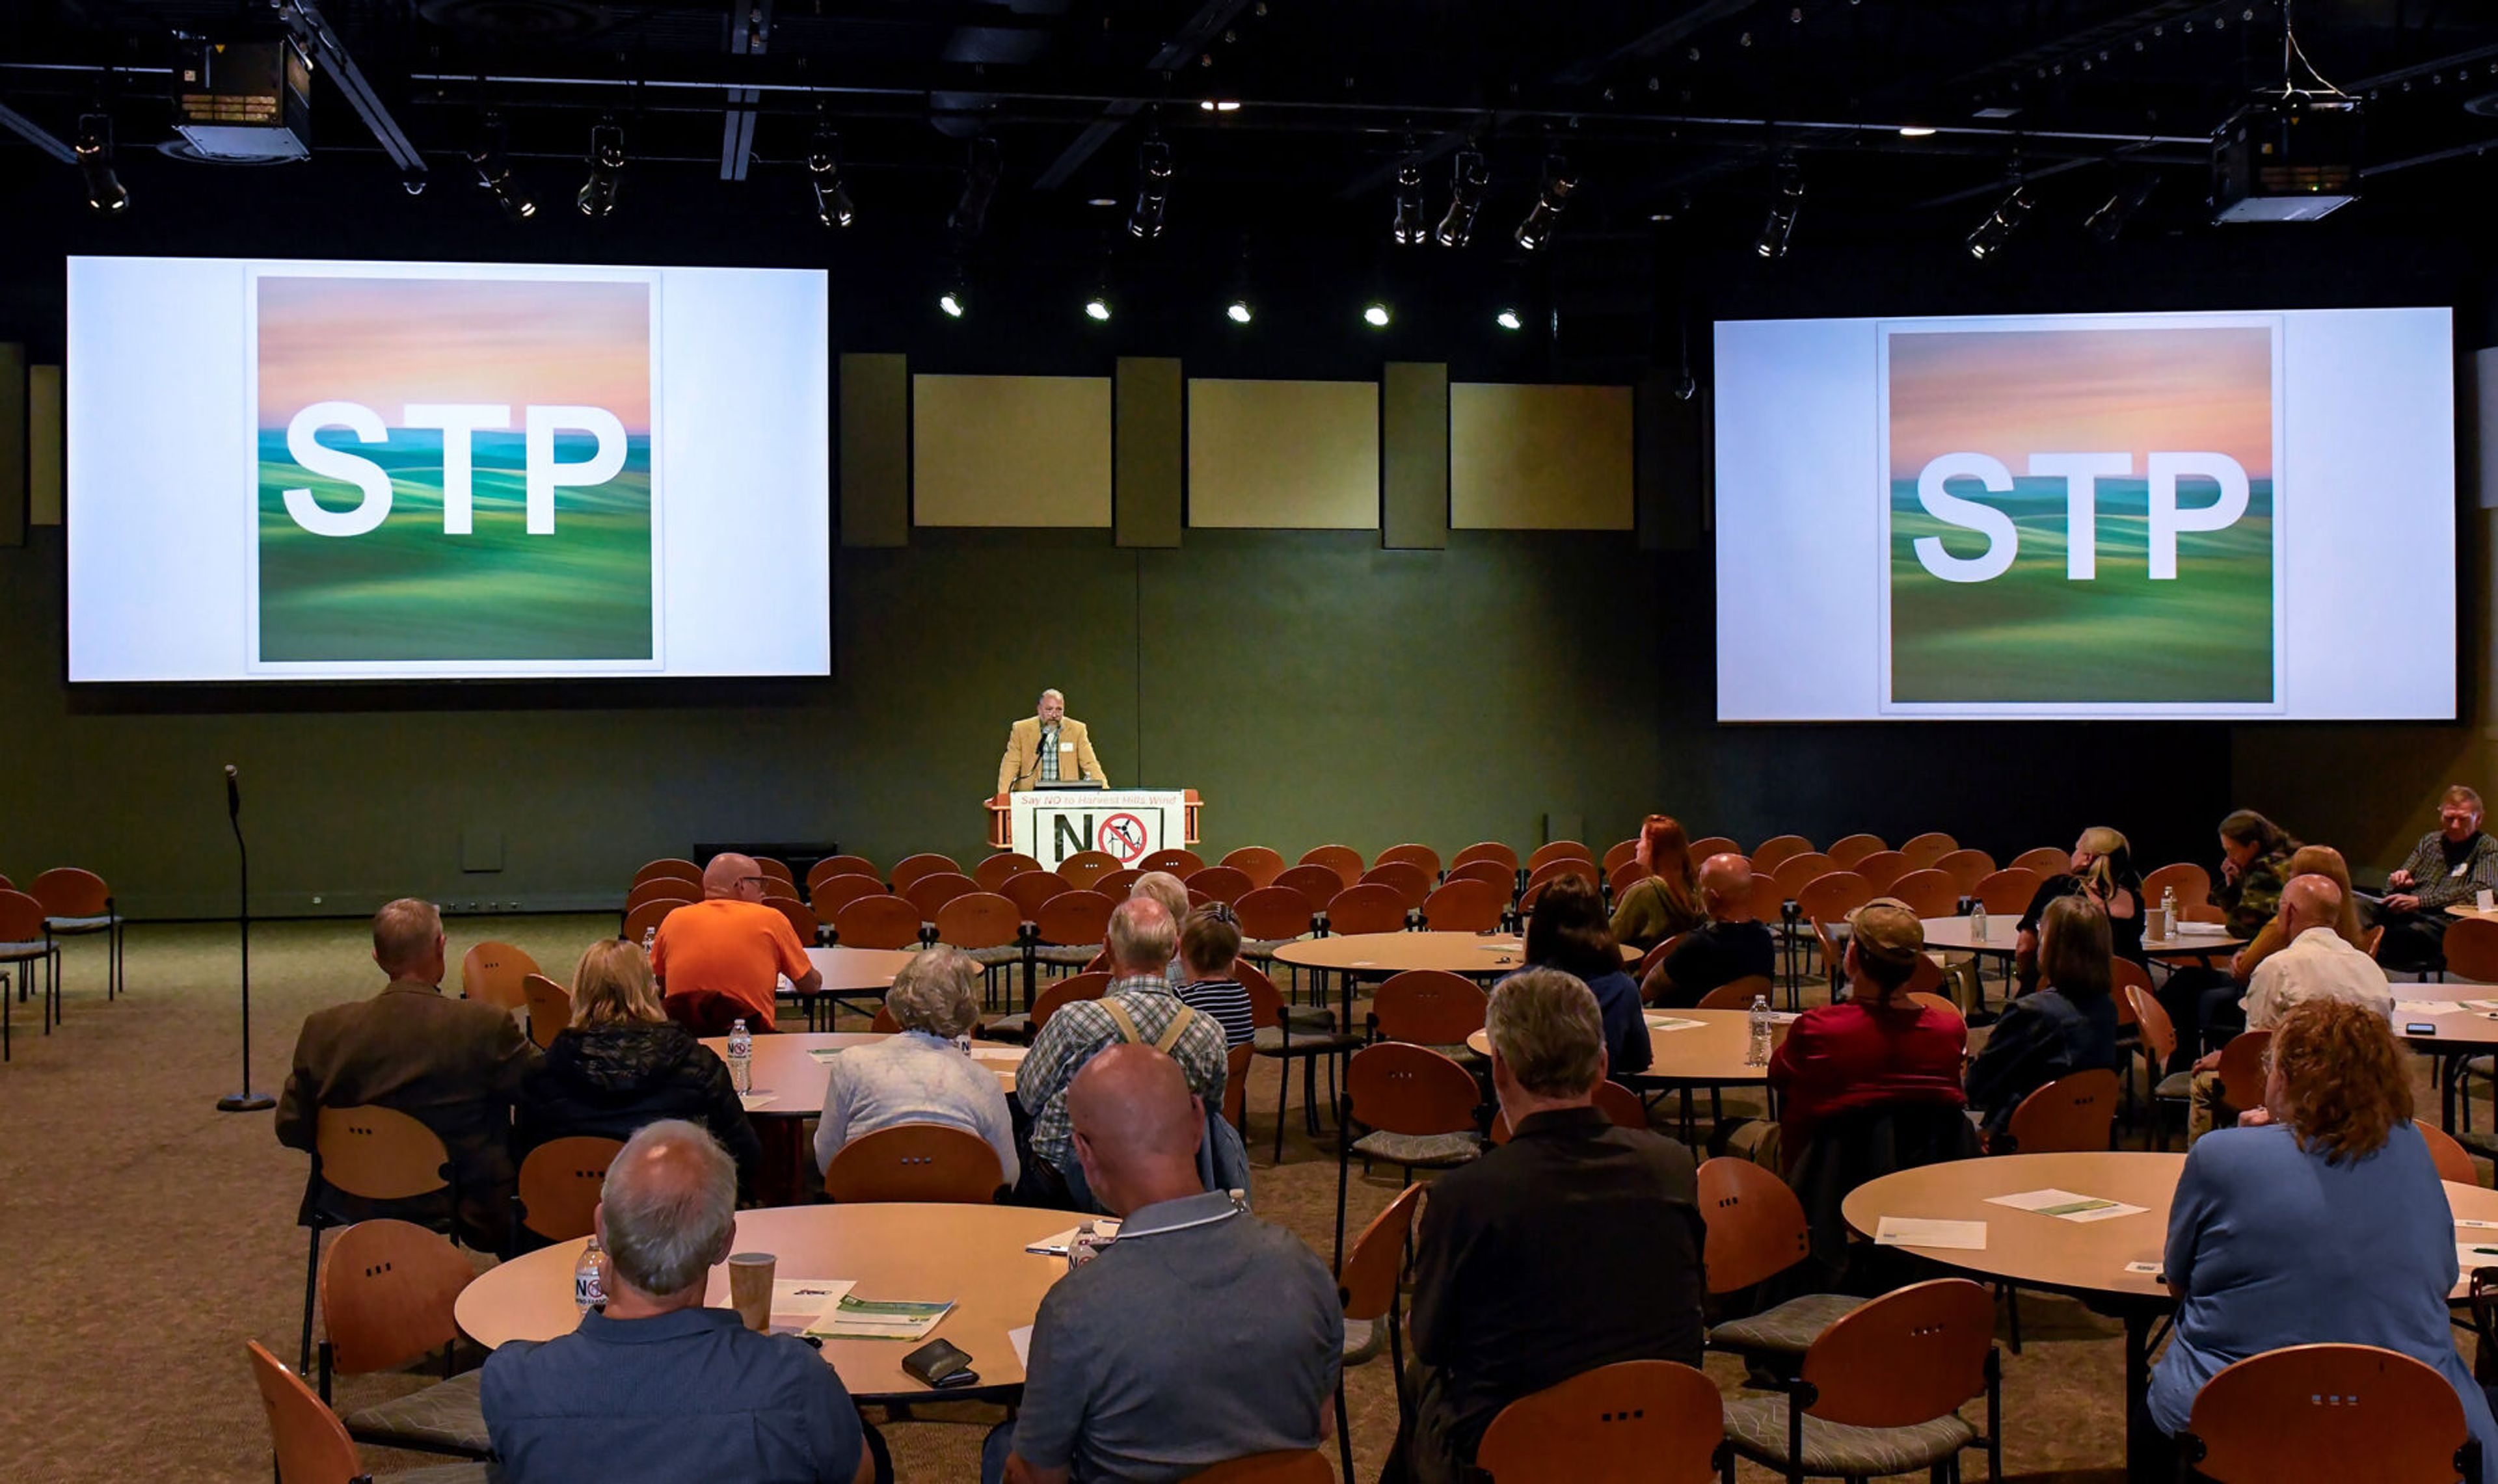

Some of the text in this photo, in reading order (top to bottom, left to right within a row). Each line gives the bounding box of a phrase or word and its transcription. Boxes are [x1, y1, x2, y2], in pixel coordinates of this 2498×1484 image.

[282, 401, 628, 537] STP
[1913, 451, 2250, 583] STP
[1021, 795, 1040, 806] Say
[1044, 795, 1062, 805] NO
[1065, 796, 1075, 805] to
